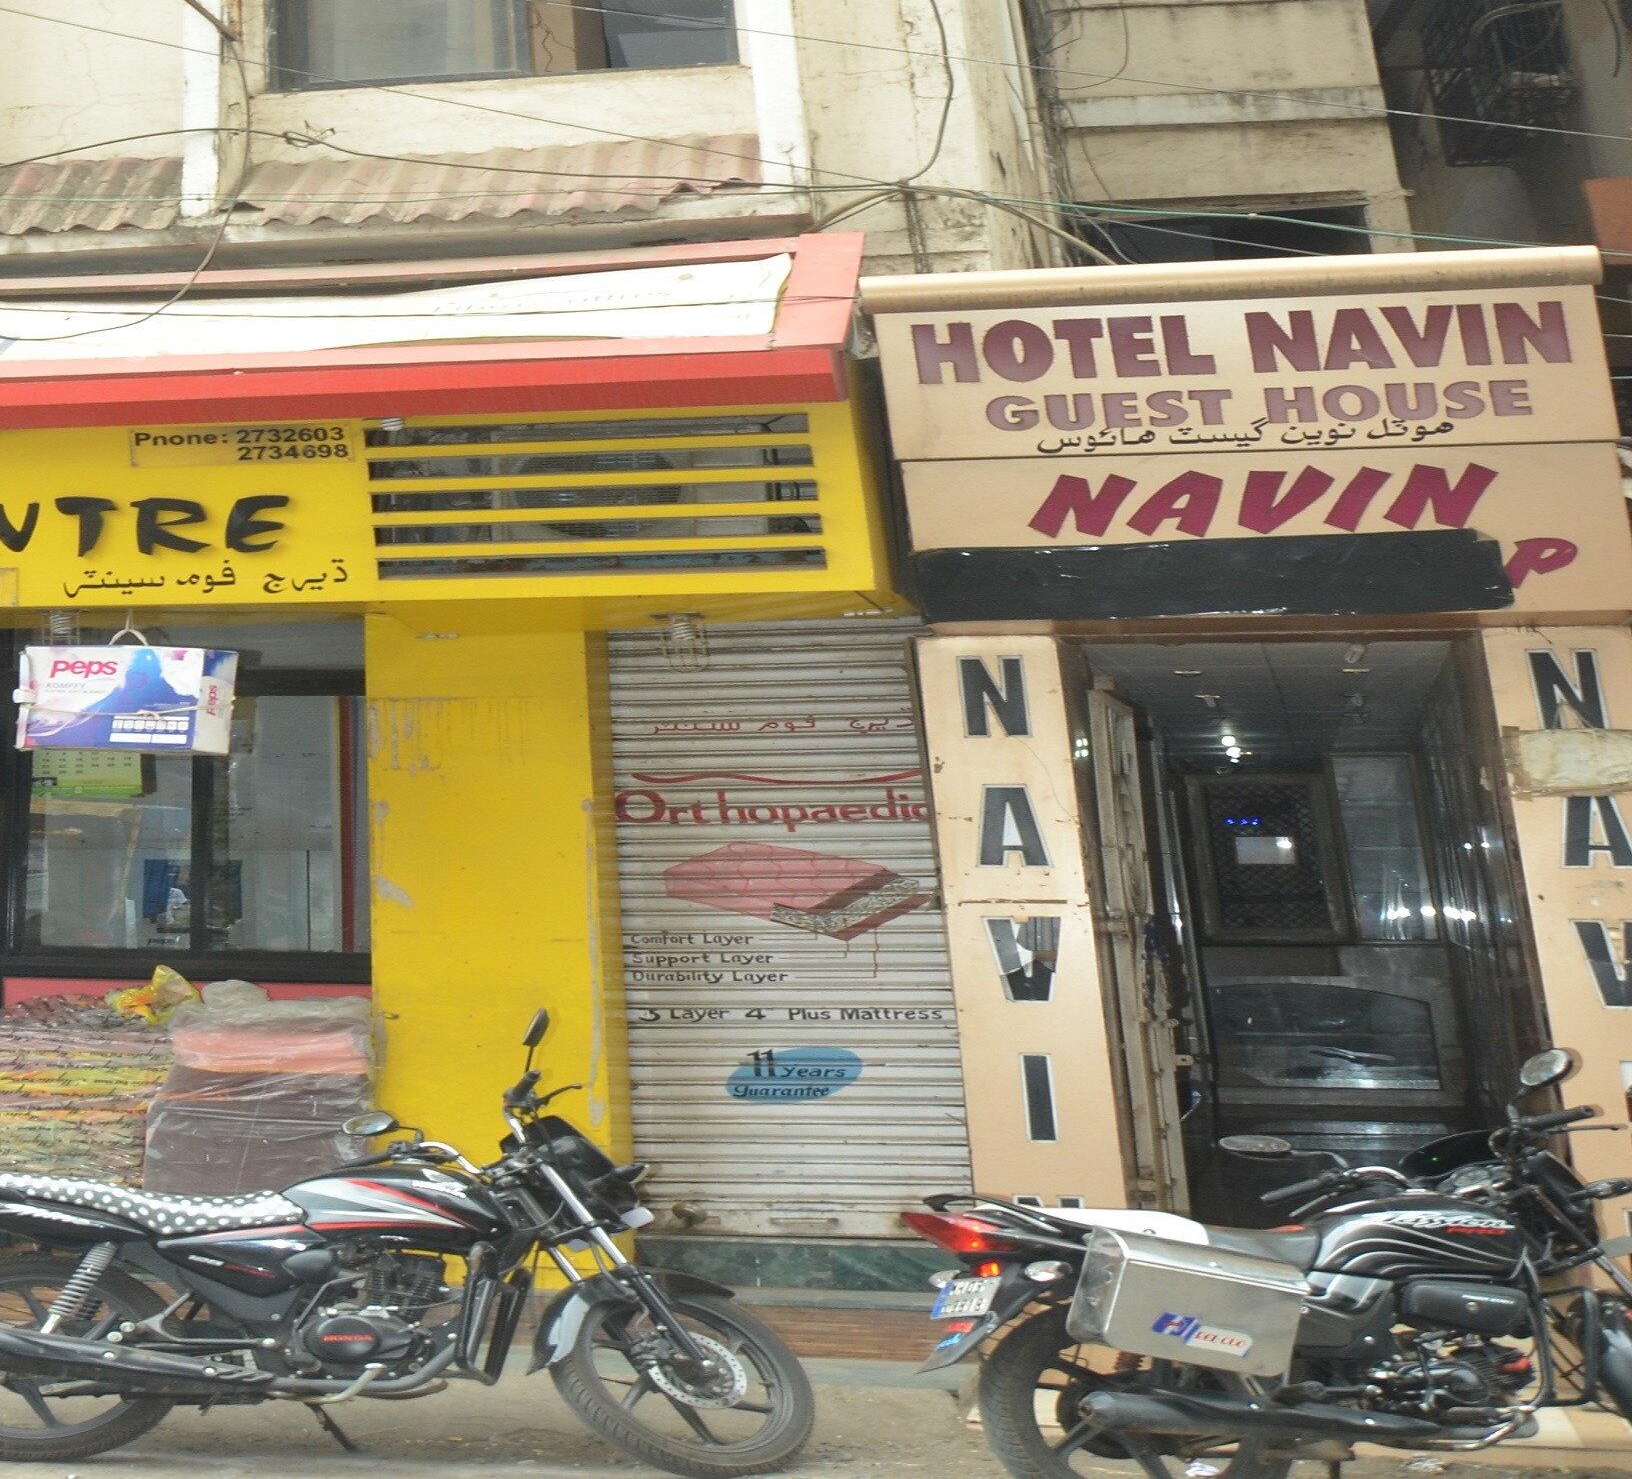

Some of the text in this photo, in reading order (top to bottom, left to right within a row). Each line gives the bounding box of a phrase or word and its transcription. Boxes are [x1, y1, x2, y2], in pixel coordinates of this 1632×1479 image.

[911, 301, 1573, 386] HOTEL NAVIN
[985, 379, 1534, 432] GUEST HOUSE
[236, 427, 344, 444] 2732603
[237, 444, 349, 460] 2734698
[1028, 463, 1499, 538] NAVIN
[50, 660, 118, 678] peps
[615, 788, 929, 833] Orthopaedic
[956, 654, 1084, 1208] NAVI
[630, 933, 754, 948] Comfort Layer
[632, 952, 774, 968] Support Layer
[633, 970, 788, 985] Durability Layer
[670, 1008, 730, 1022] Layer
[788, 1008, 832, 1022] Plus
[840, 1008, 943, 1021] Mattress
[747, 1048, 777, 1078] 11
